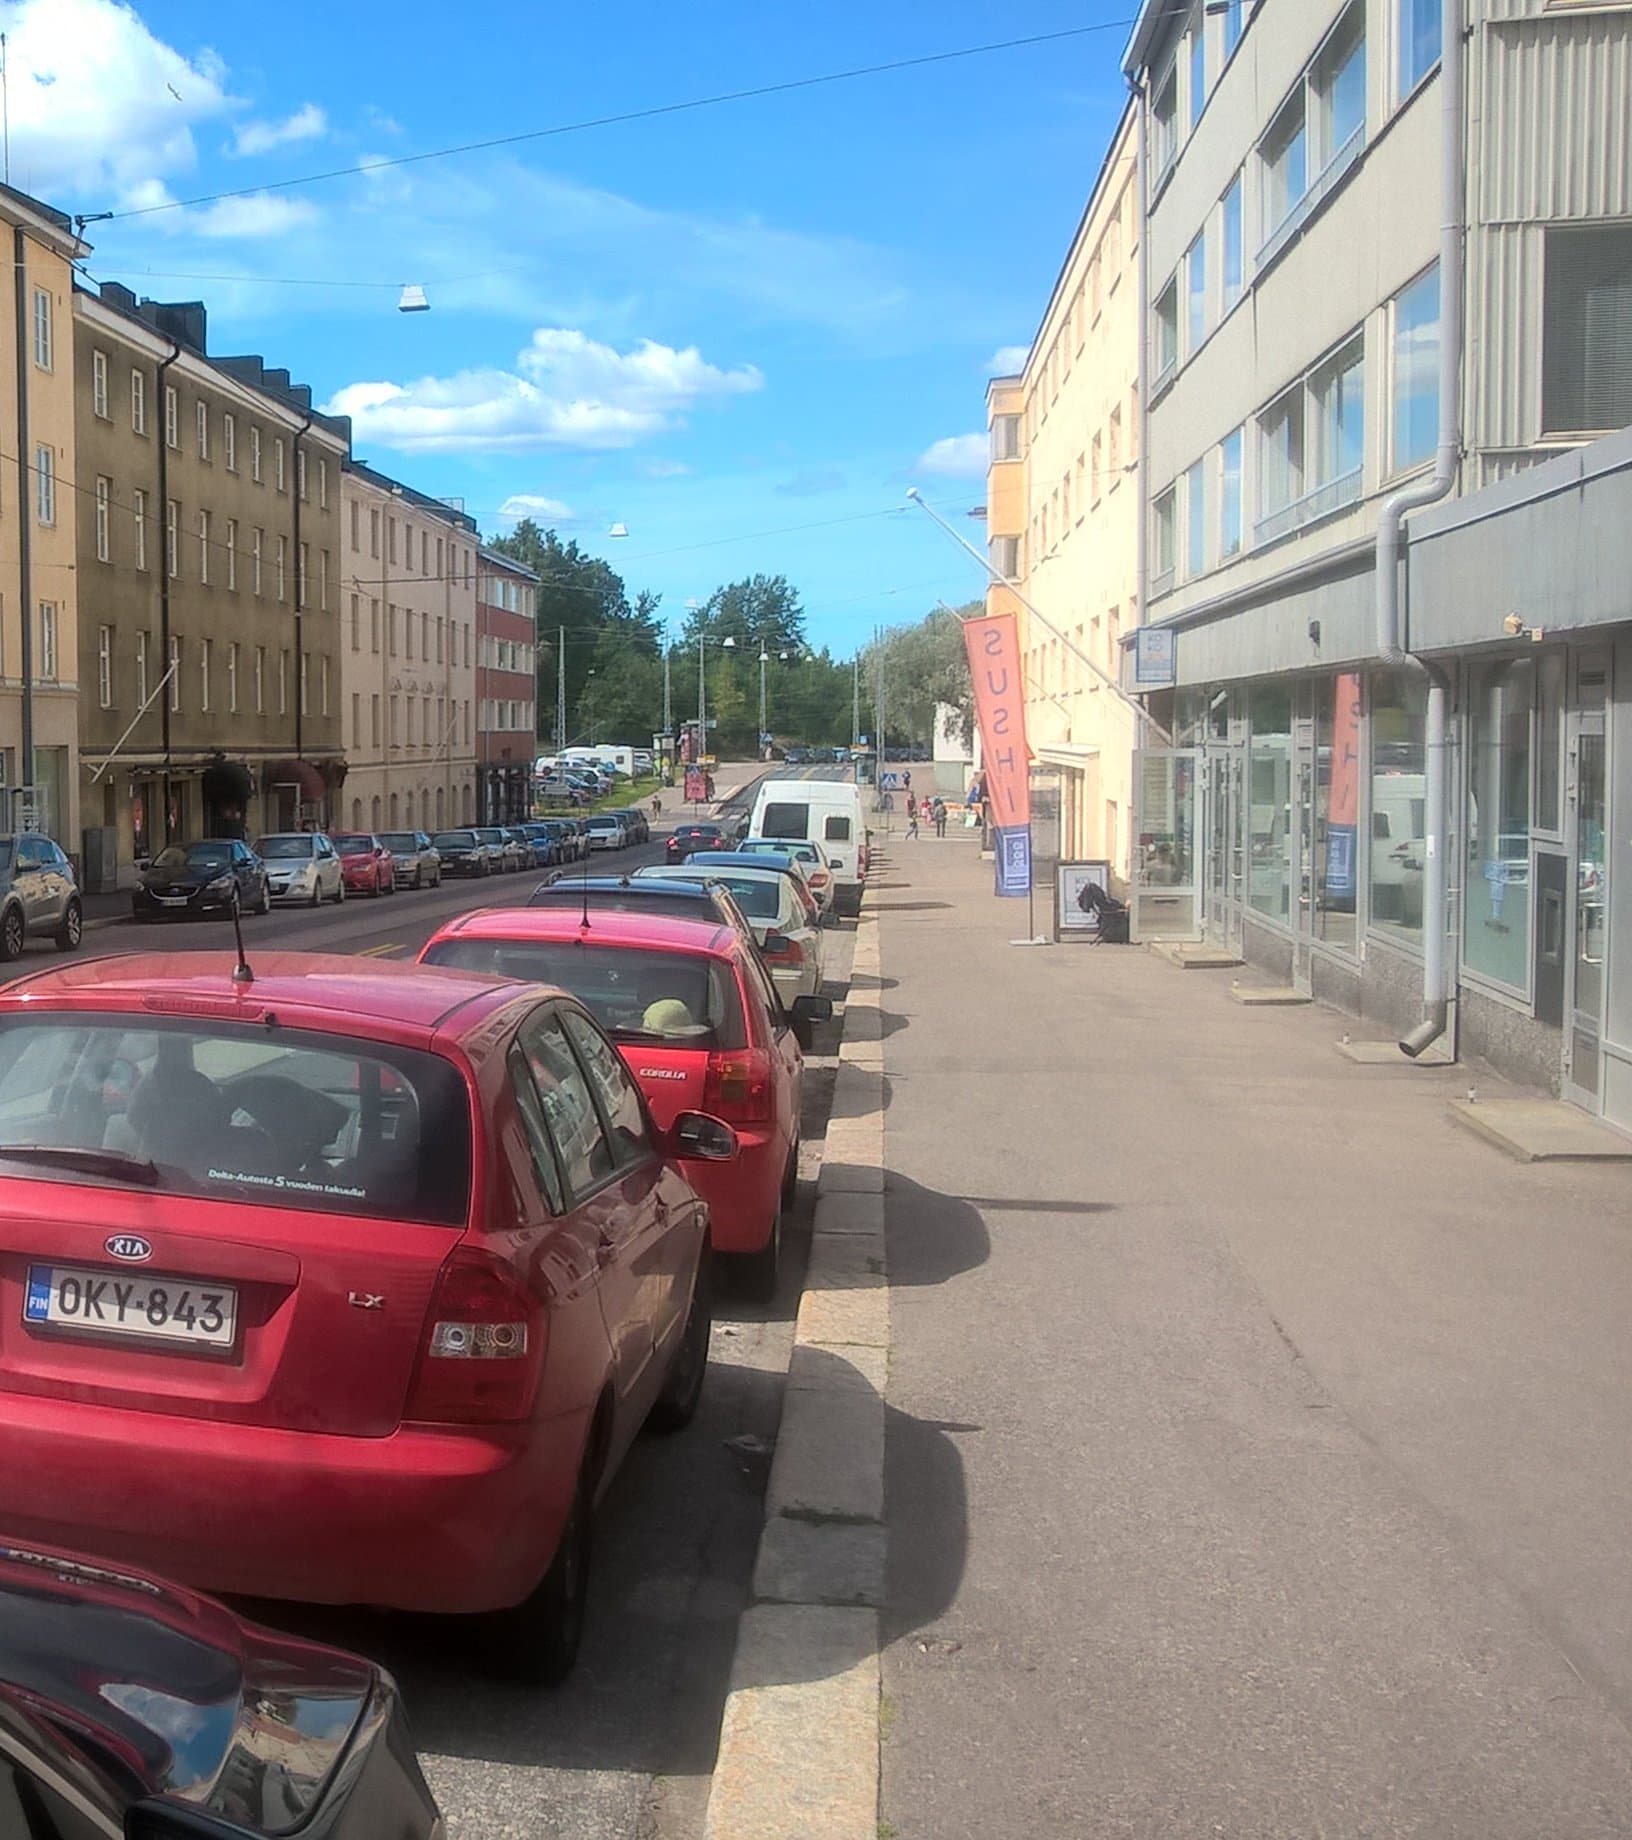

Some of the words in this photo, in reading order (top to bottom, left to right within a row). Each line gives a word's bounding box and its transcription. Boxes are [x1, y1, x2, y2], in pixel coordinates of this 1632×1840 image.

[639, 1068, 686, 1079] COROLLA
[207, 1168, 274, 1186] Delta-Autosta
[274, 1175, 285, 1188] 5
[286, 1181, 324, 1192] vuoden
[112, 1239, 145, 1255] KIA
[28, 1296, 49, 1311] FIN
[58, 1277, 225, 1334] OKY-843
[348, 1291, 384, 1309] LX
